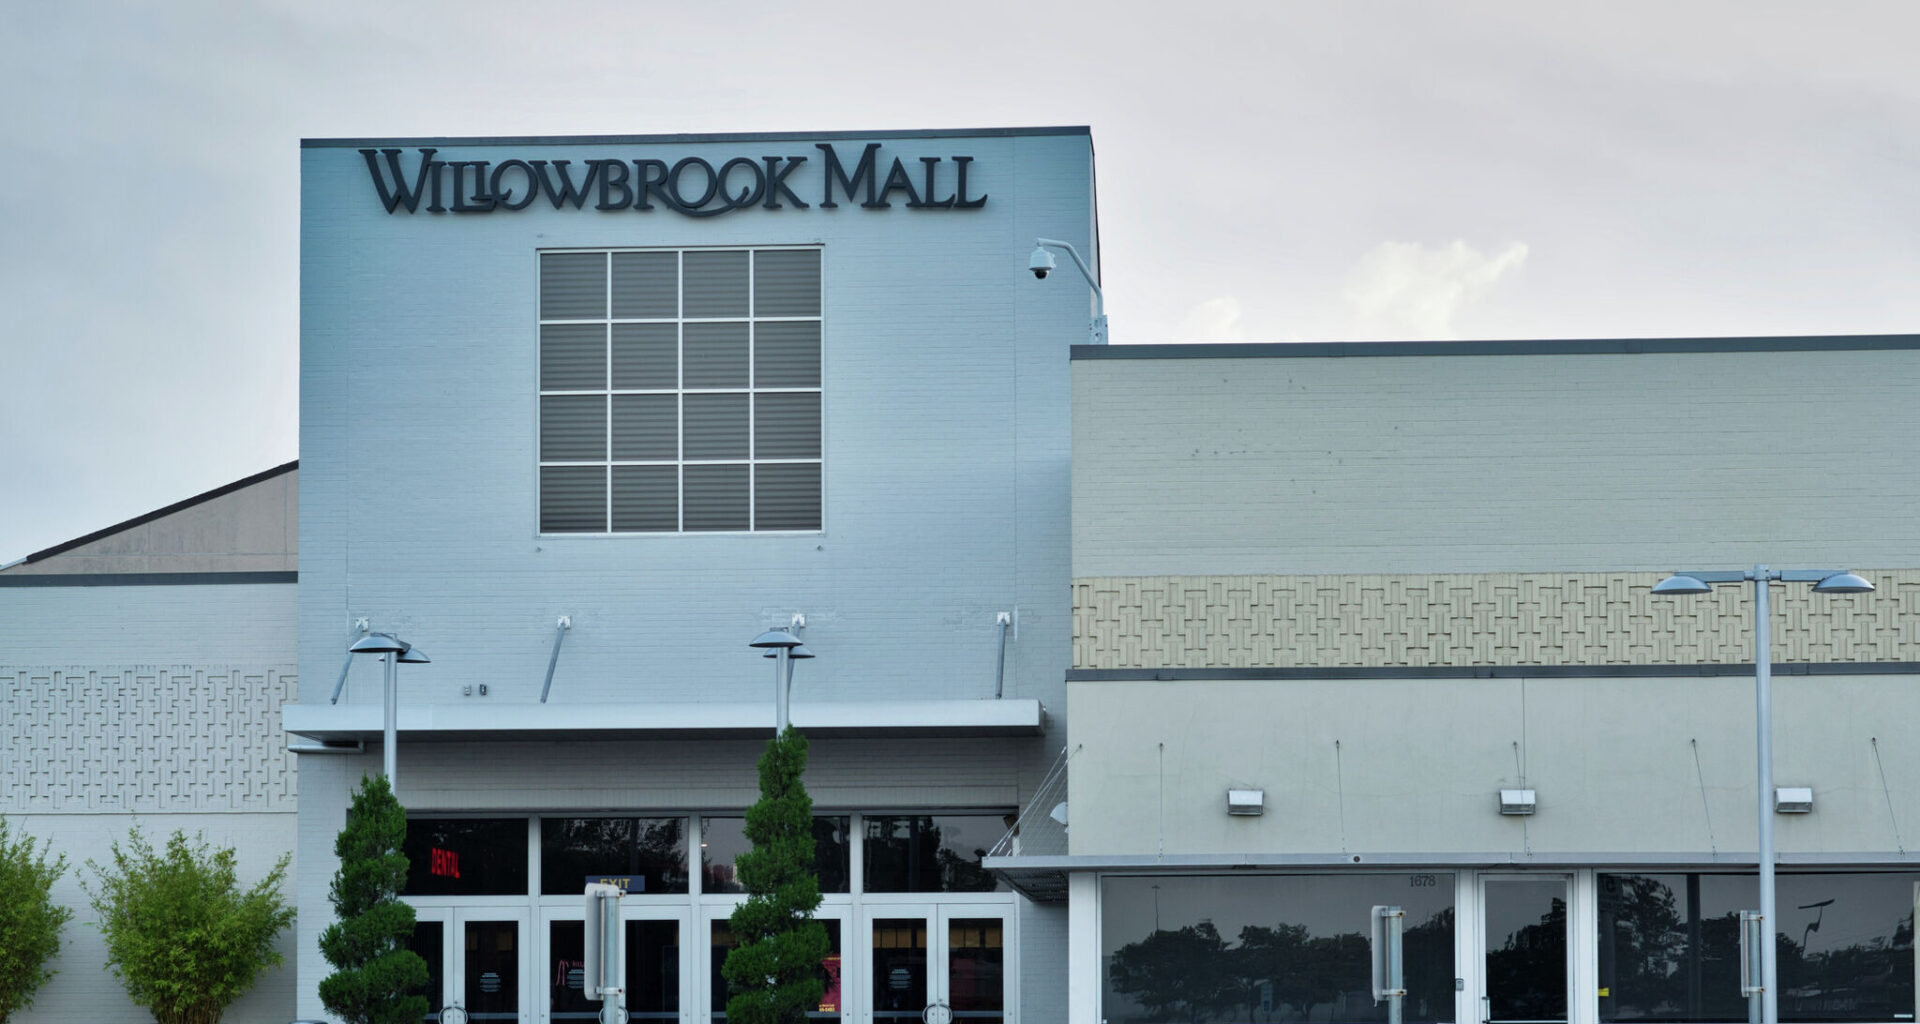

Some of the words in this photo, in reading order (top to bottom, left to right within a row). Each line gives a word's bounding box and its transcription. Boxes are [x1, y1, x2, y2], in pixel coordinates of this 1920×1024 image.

[358, 148, 810, 218] WILLOWBROOK
[815, 143, 988, 209] MALL
[431, 847, 461, 879] DENTAL
[1409, 875, 1436, 887] 1678
